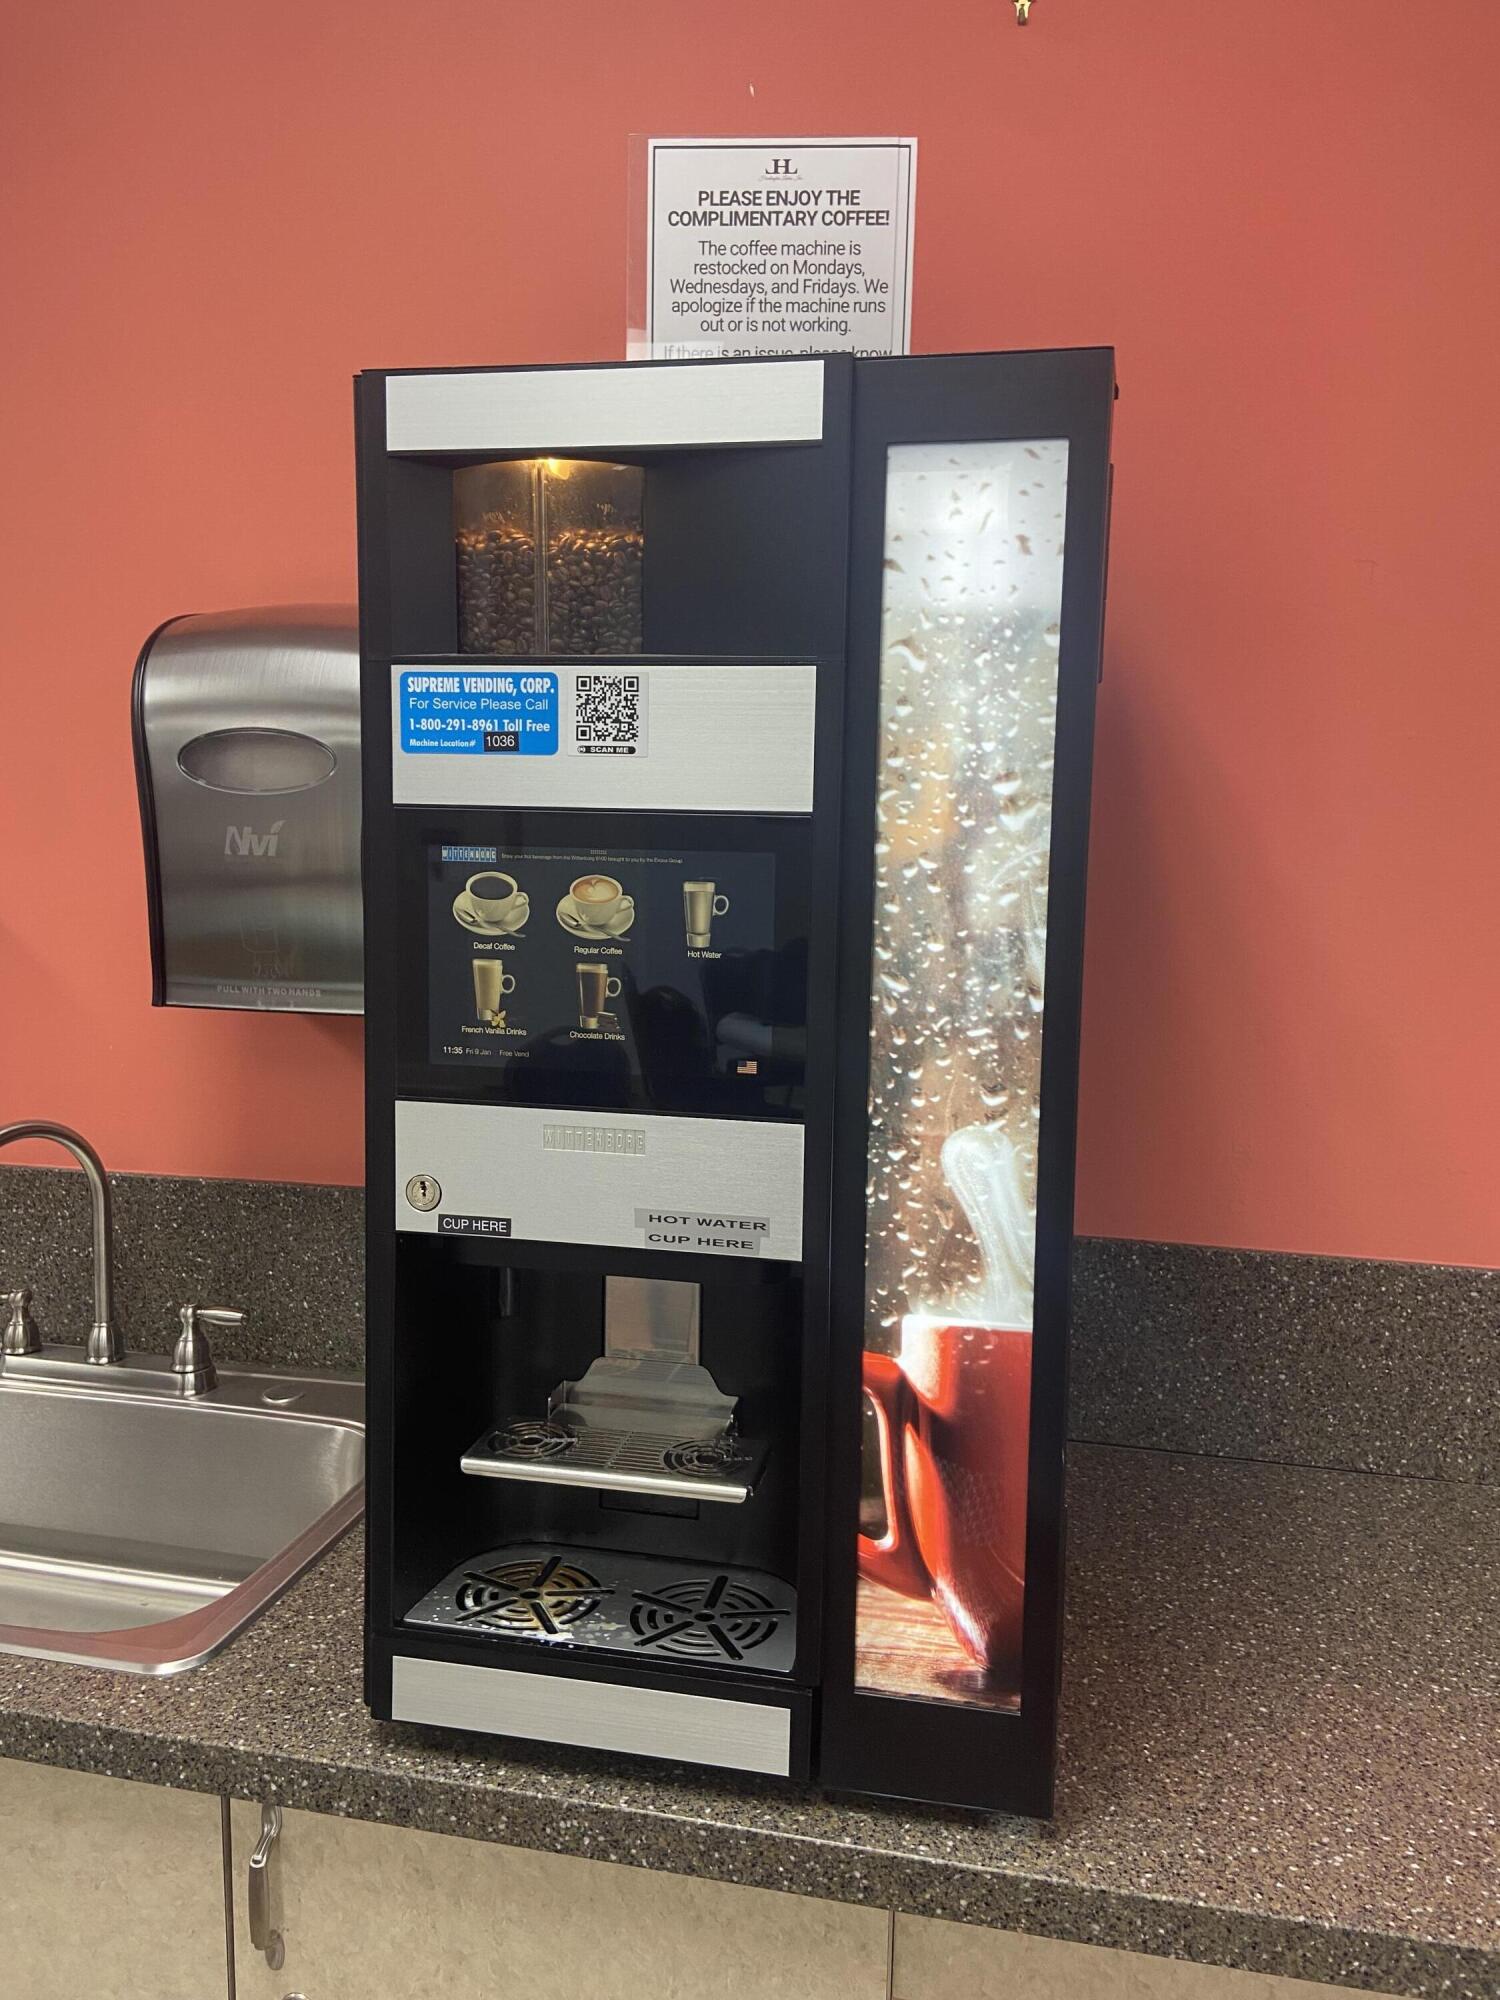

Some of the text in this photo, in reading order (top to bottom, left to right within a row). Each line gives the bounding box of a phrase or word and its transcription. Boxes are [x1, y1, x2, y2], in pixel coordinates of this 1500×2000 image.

[698, 190, 861, 207] PLEASE ENJOY THE
[668, 210, 890, 227] COMPLIMENTARY COFFEE!
[698, 240, 861, 256] The coffee machine is
[694, 259, 865, 279] restocked on Mondays,
[670, 278, 889, 298] Wednesdays, and Fridays. We
[671, 298, 886, 317] apologize if the machine runs
[700, 317, 851, 336] out or is not working.
[408, 676, 555, 696] SUPREME VENDING, CORP.
[409, 698, 549, 711] For Service Please Call
[409, 718, 550, 732] 1-800-291-8961 Toll Free
[409, 739, 439, 747] Machine
[486, 735, 515, 747] 1036
[473, 942, 516, 951] Decaf Coffee
[574, 946, 623, 955] Regular Coffee
[688, 951, 722, 960] Hot Water
[217, 984, 321, 997] PULL WITH TWO HANDS
[461, 1026, 527, 1036] French Vanilla Drinks
[569, 1031, 626, 1041] Chocolate Drinks
[443, 1046, 463, 1055] 11:35
[514, 1050, 530, 1058] Vend
[543, 1126, 645, 1153] WITTENBORG
[443, 1216, 507, 1233] CUP HERE
[648, 1213, 767, 1232] HOT WATER
[648, 1233, 754, 1250] CUP HERE
